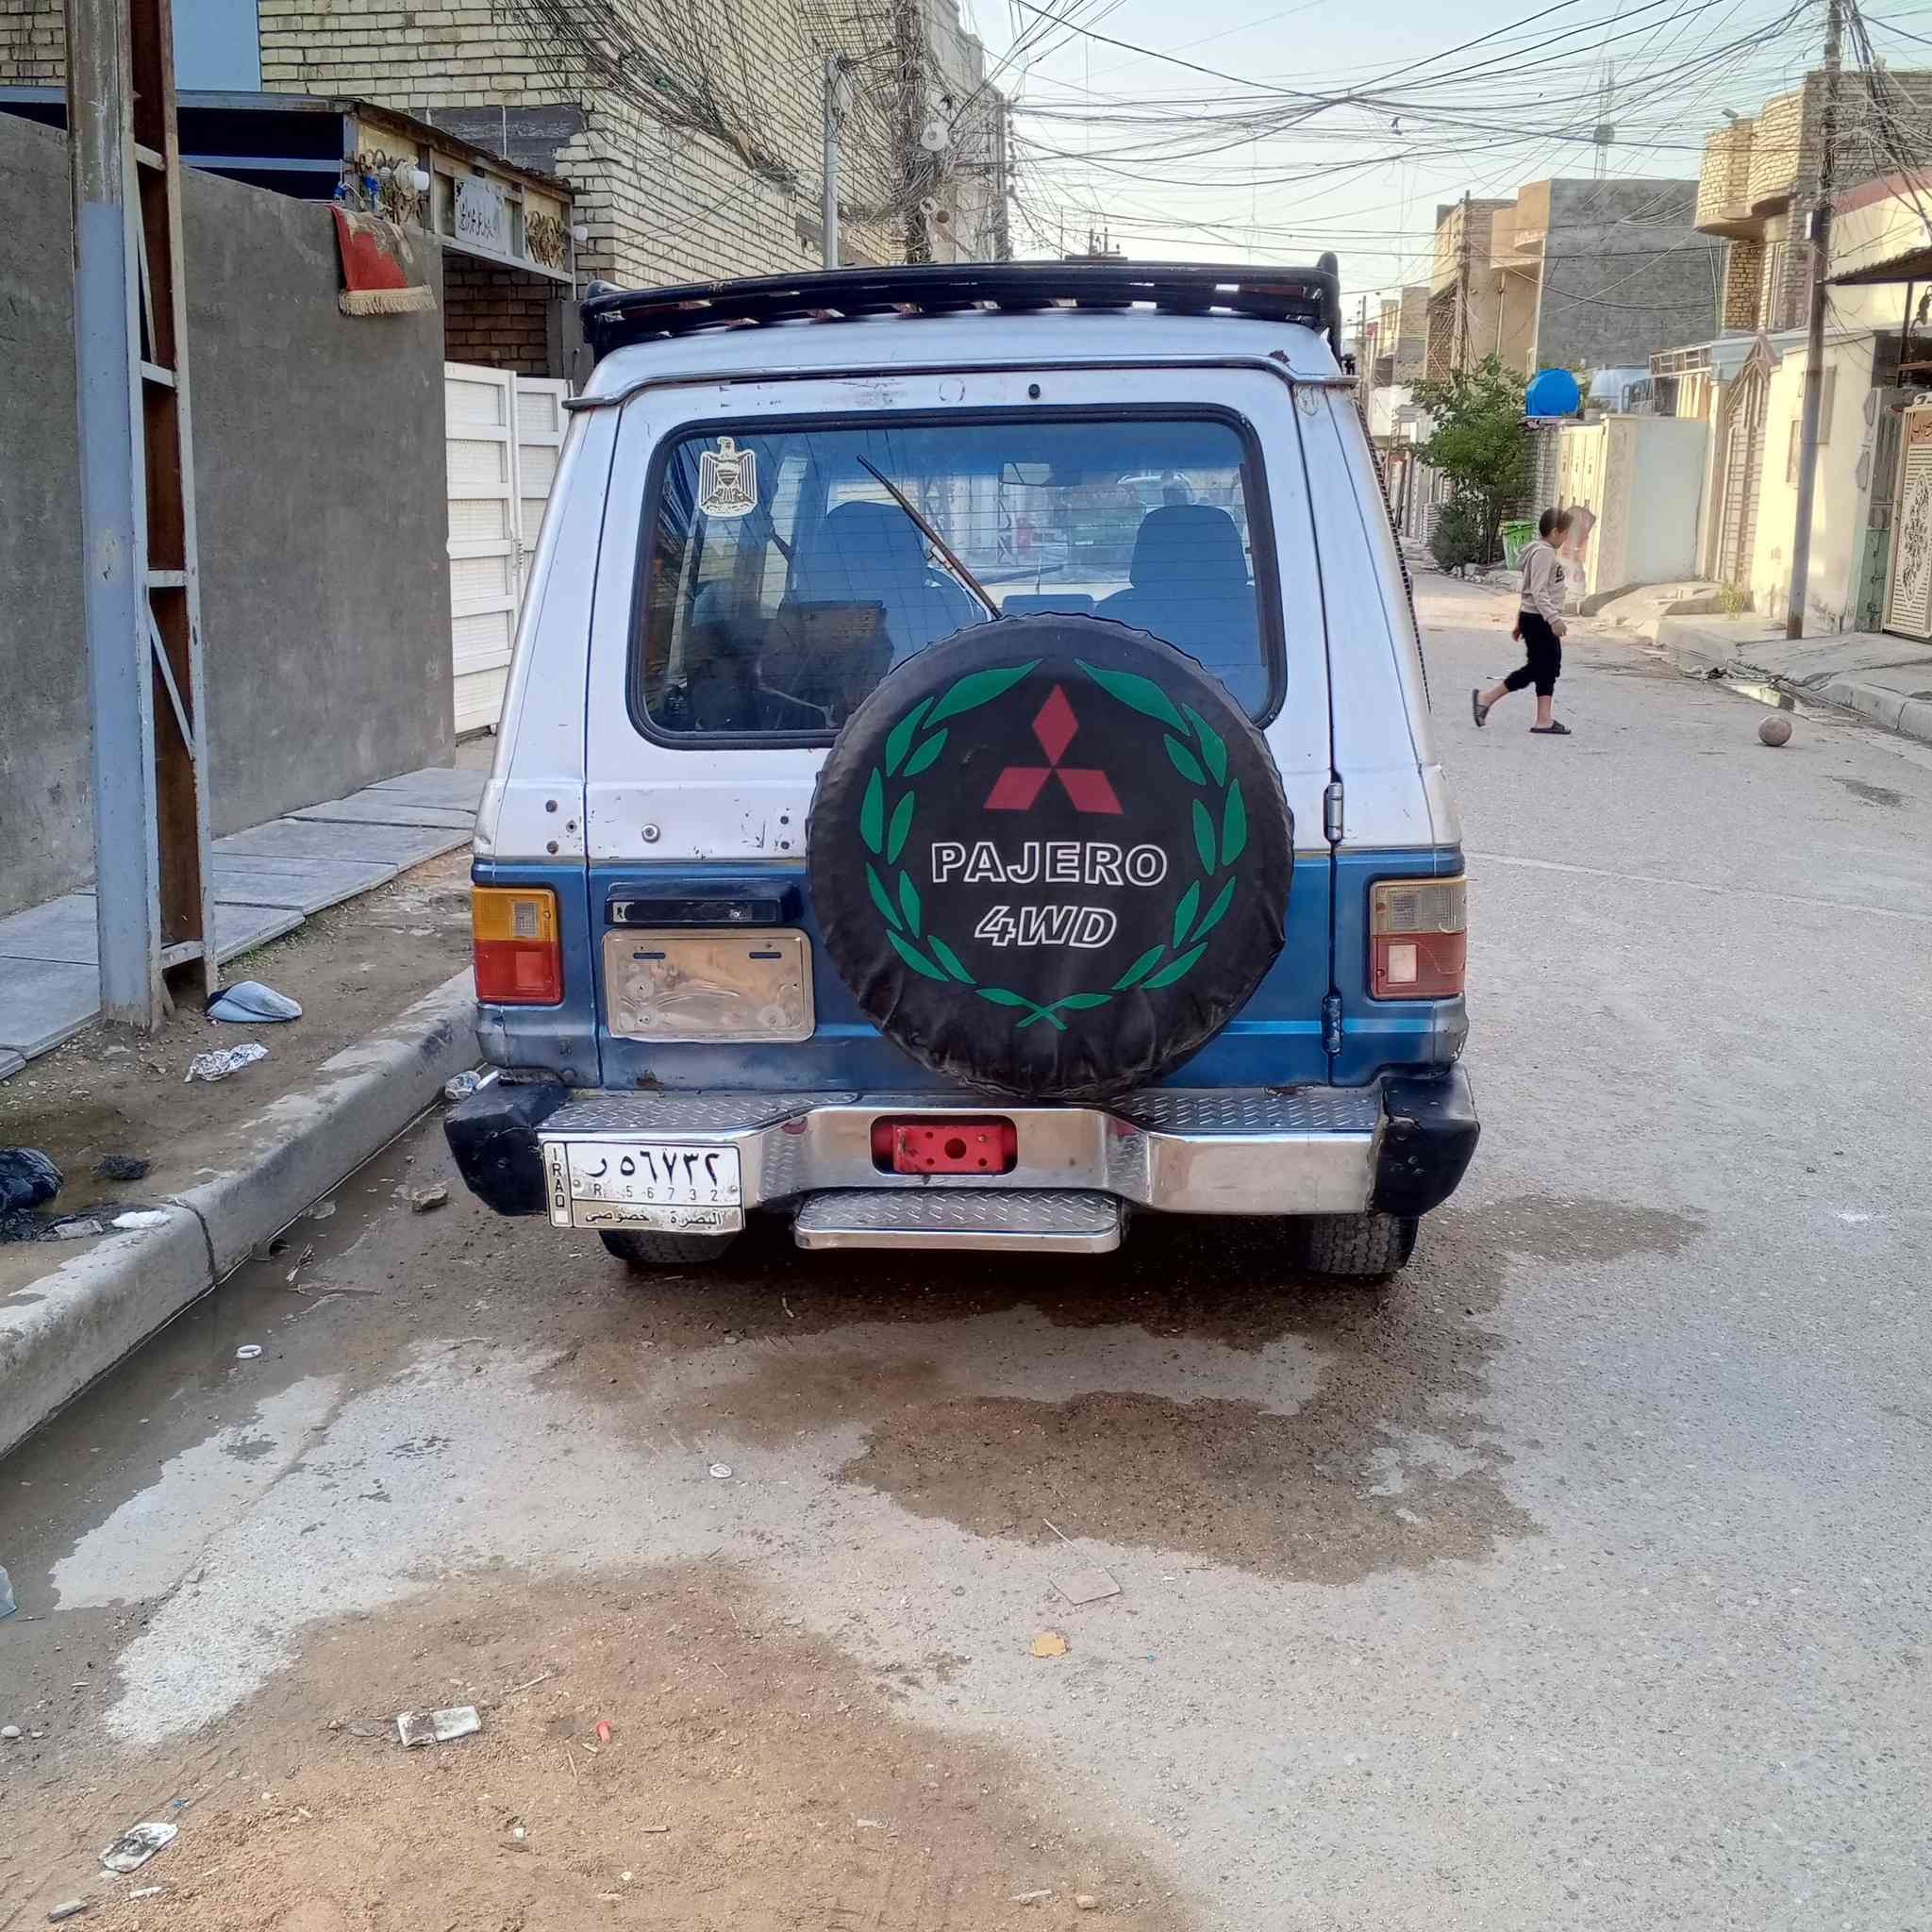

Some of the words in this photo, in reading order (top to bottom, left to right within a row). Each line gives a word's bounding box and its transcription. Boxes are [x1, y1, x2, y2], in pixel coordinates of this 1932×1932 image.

[931, 841, 1168, 887] PAJERO
[974, 905, 1118, 949] 4WD
[551, 1147, 566, 1208] IRAQ
[585, 1210, 650, 1225] خصوصي
[670, 1209, 723, 1229] البصرة
